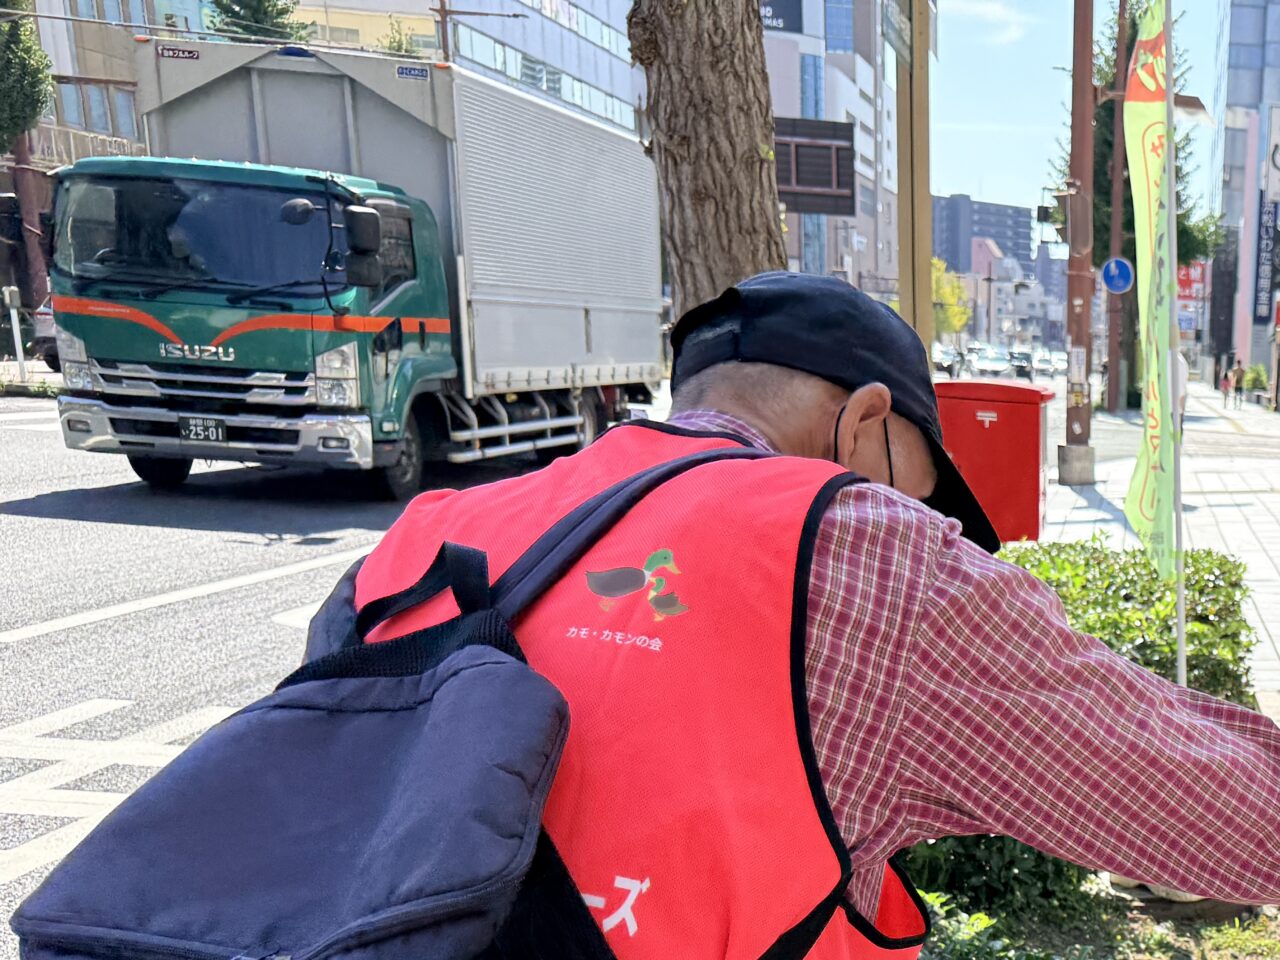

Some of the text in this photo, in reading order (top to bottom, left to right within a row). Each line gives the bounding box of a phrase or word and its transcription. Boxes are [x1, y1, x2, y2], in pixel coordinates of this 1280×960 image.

[159, 342, 235, 362] ISUZU
[566, 626, 664, 652] カモ・カモンの会
